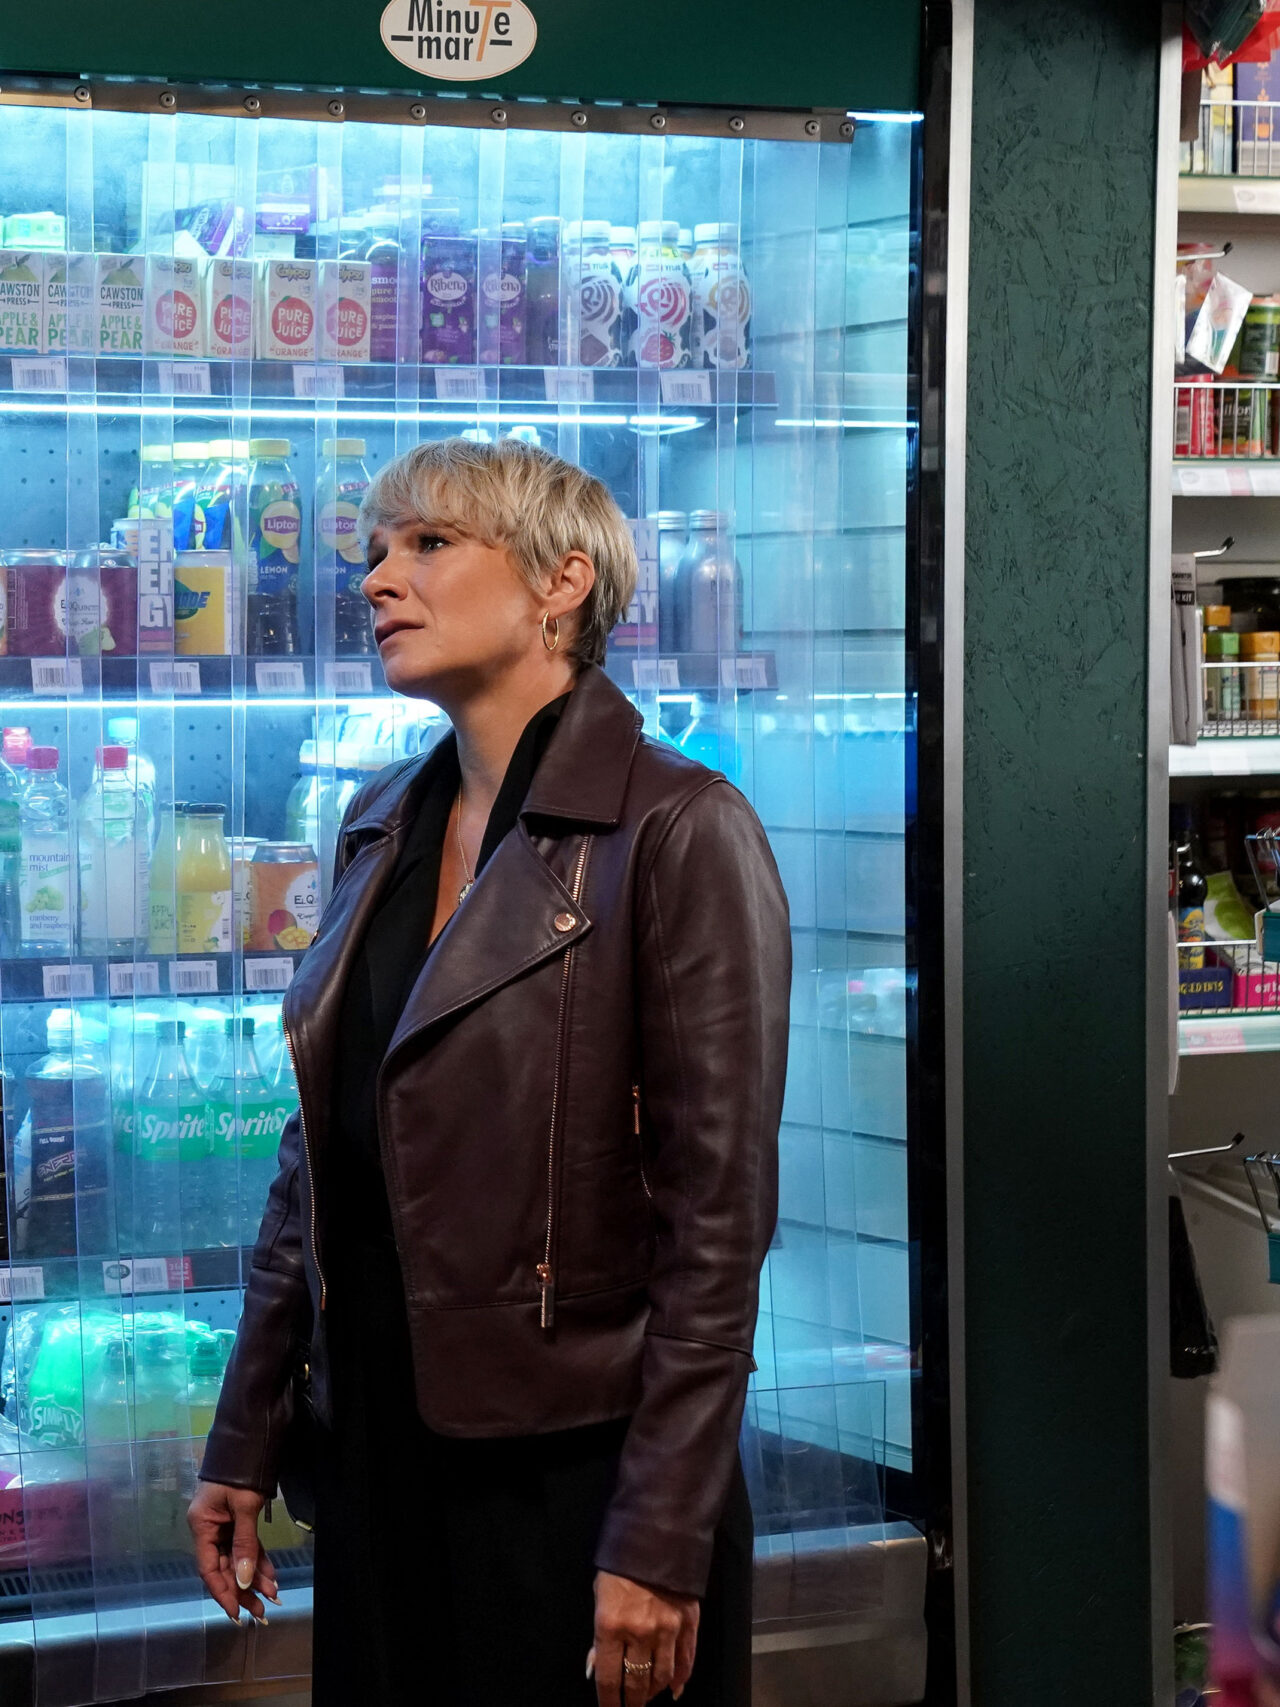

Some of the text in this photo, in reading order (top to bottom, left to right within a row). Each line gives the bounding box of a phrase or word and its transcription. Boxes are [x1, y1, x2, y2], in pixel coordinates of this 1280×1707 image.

[430, 277, 466, 293] Ribena
[100, 286, 144, 300] CAWSTON
[6, 297, 26, 306] PRESS
[112, 301, 131, 310] PRESS
[29, 312, 39, 327] &
[101, 315, 142, 330] APPLE &
[278, 308, 309, 324] PURE
[100, 330, 143, 350] PEAR
[275, 348, 309, 357] ORANGE
[267, 518, 298, 533] Lipton
[260, 566, 288, 574] LEMON
[29, 863, 49, 872] mist
[142, 1113, 206, 1144] Sprite
[215, 1110, 276, 1142] Sprite
